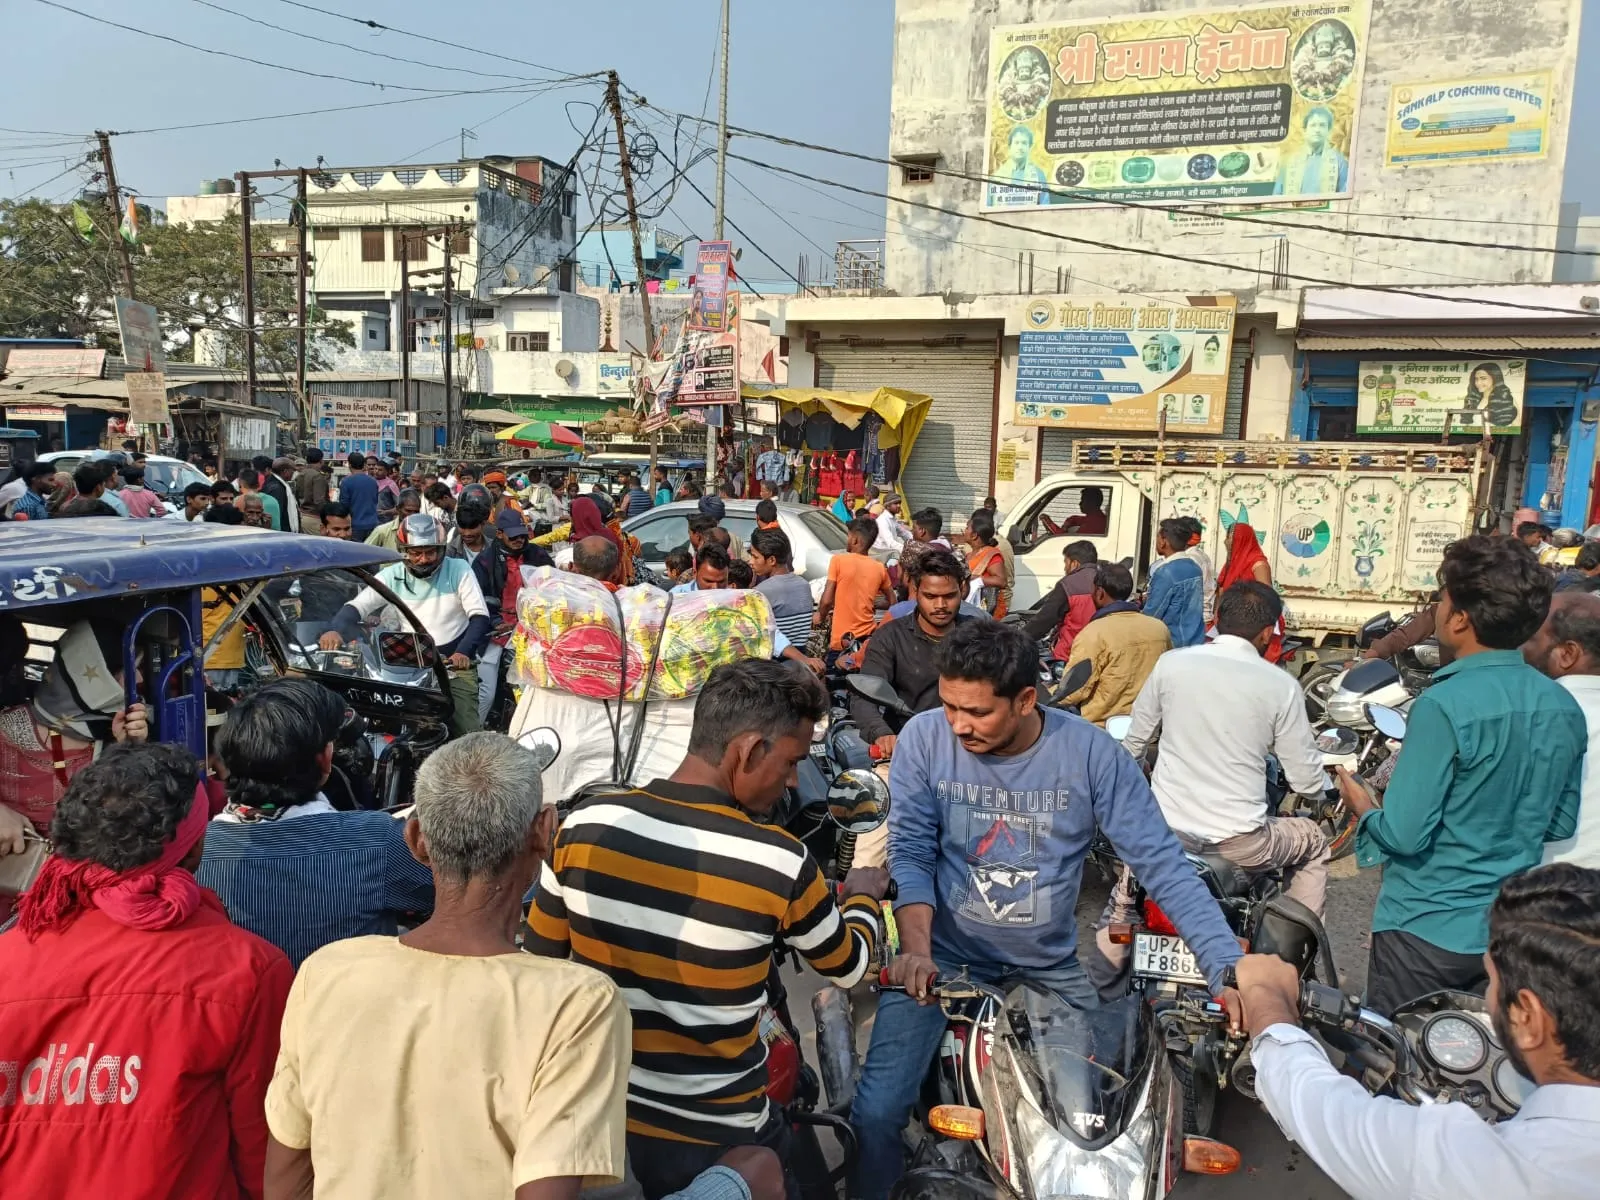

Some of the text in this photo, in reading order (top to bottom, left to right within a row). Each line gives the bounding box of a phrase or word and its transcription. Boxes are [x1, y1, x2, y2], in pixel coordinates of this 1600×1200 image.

[1057, 31, 1098, 84] श्री
[1103, 36, 1191, 82] श्याम
[1396, 86, 1542, 121] SANKALP COACHING CENTER
[1175, 306, 1231, 328] अस्पताल
[1398, 362, 1430, 375] दुनिया
[1432, 365, 1448, 373] का
[1404, 374, 1462, 384] हेयर ऑयल
[1298, 528, 1312, 541] UP
[937, 780, 1069, 812] ADVENTURE
[992, 813, 999, 821] TO
[1014, 816, 1029, 824] FREE
[1073, 1112, 1105, 1128] TVS
